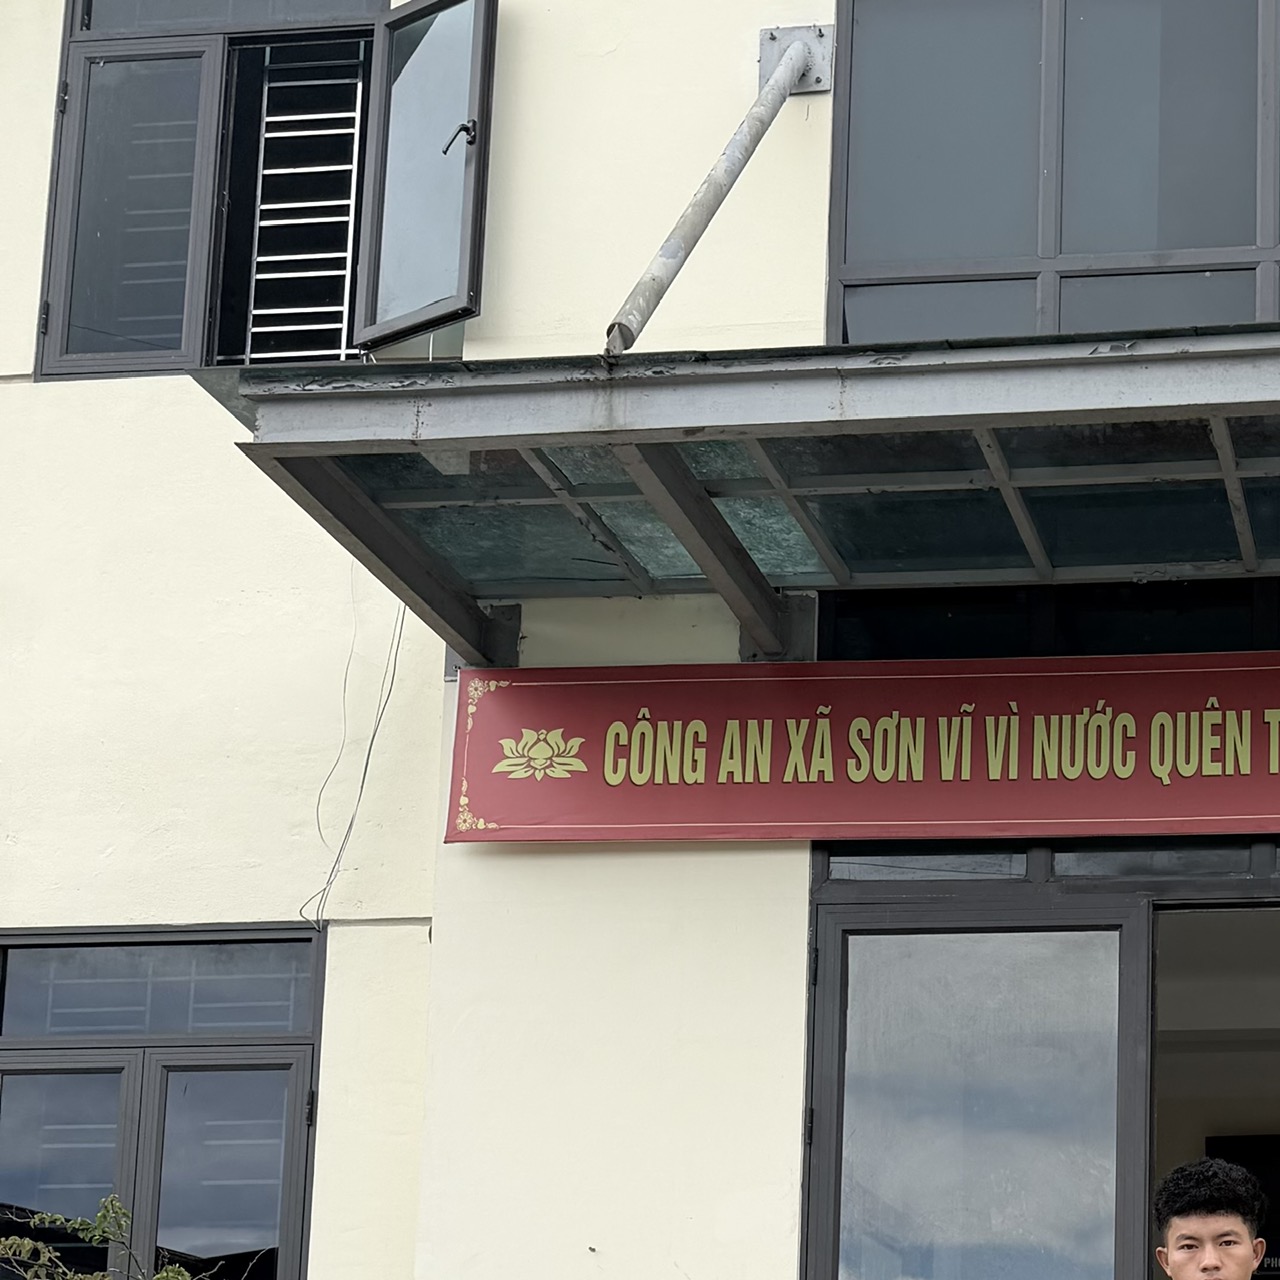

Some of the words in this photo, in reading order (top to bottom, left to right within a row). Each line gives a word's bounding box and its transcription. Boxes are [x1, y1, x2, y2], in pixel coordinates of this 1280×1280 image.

[604, 707, 707, 786] CÔNG
[717, 719, 773, 784] AN
[782, 705, 834, 783] XÃ
[847, 710, 925, 783] SƠN
[938, 703, 975, 781] VĨ
[985, 701, 1019, 780] VÌ
[1032, 699, 1136, 781] NƯỚC
[1150, 696, 1251, 785] QUÊN
